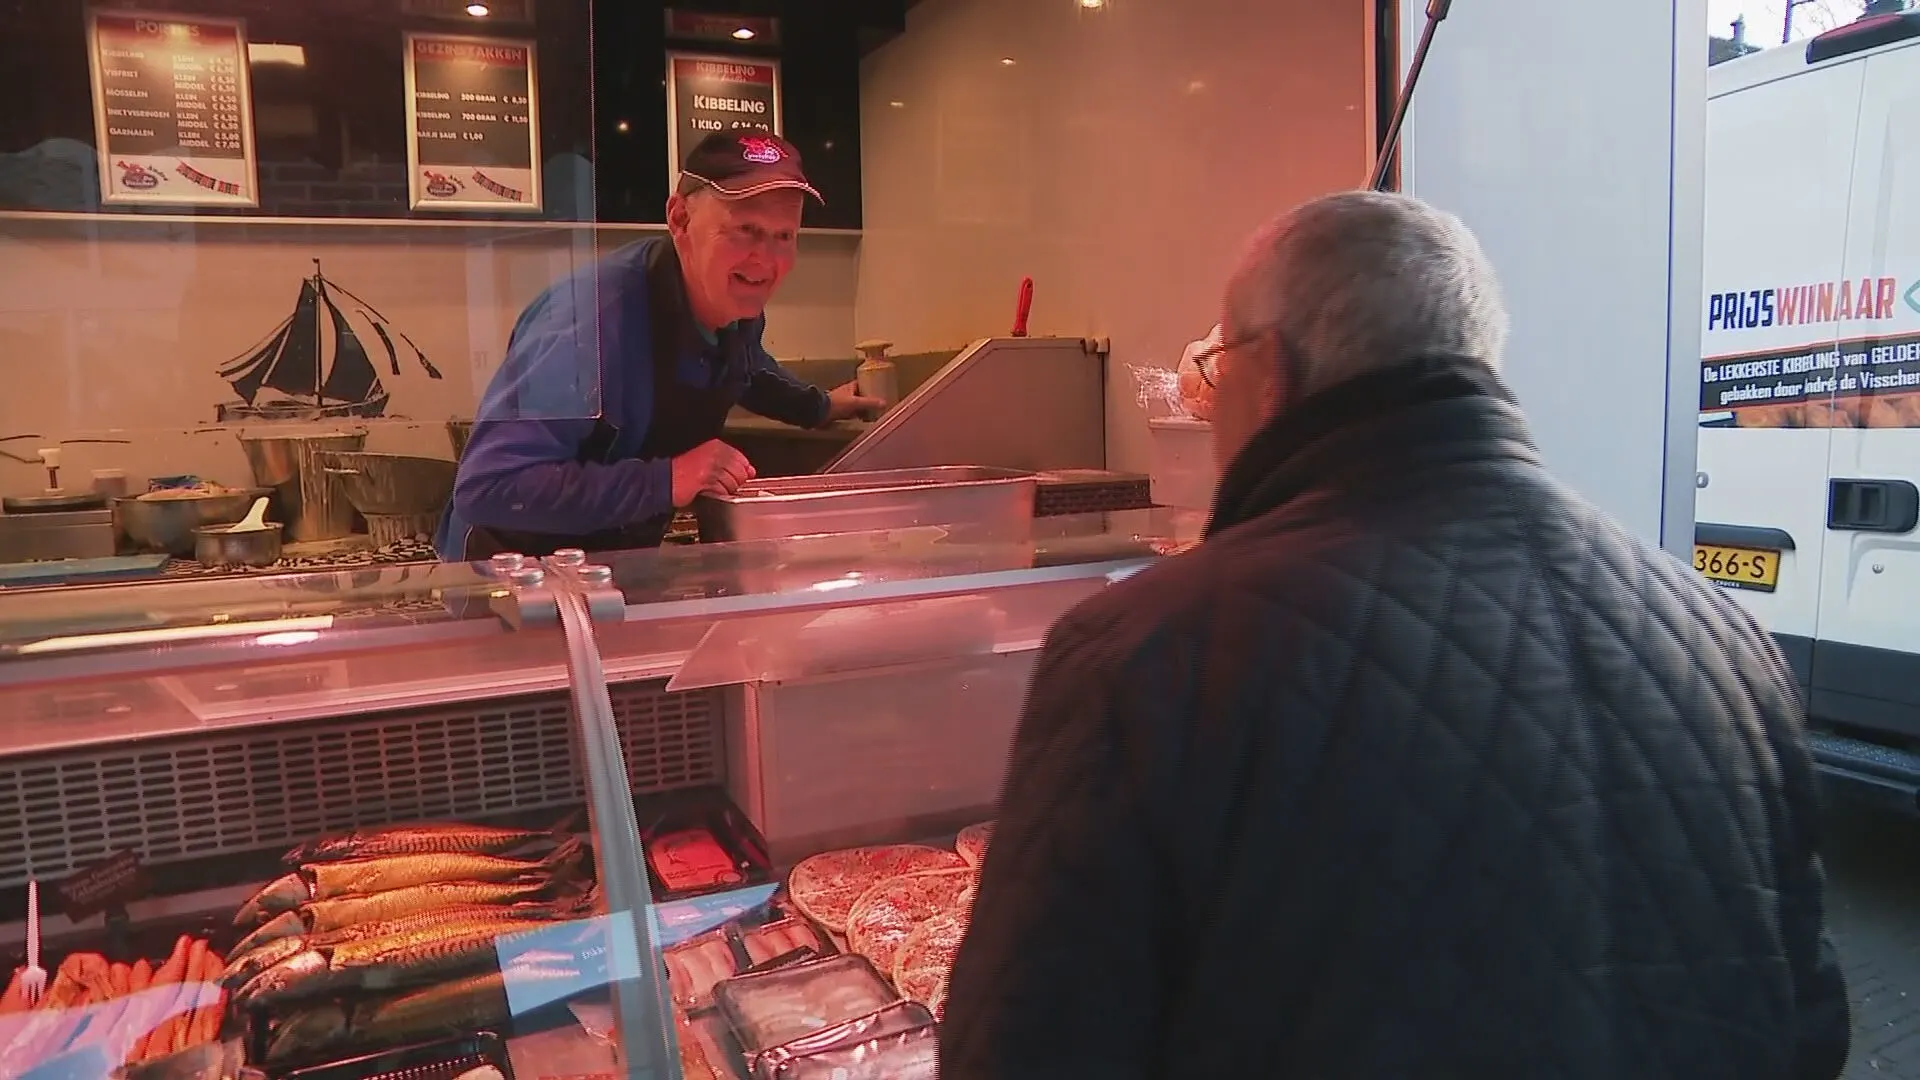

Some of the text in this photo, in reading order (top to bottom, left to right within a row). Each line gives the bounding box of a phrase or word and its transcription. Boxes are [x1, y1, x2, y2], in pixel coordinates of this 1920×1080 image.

[106, 88, 149, 98] MOSSELEN
[693, 94, 765, 113] KIBBELING
[109, 127, 154, 137] GARNALEN
[691, 118, 696, 129] 1
[698, 119, 722, 130] KILO
[1703, 366, 1718, 383] De
[1719, 358, 1780, 381] LEKKERSTE
[1842, 353, 1868, 366] van
[1719, 382, 1773, 405] gebakken
[1774, 380, 1803, 397] door
[1840, 373, 1857, 390] de
[1694, 549, 1766, 579] 366-S
